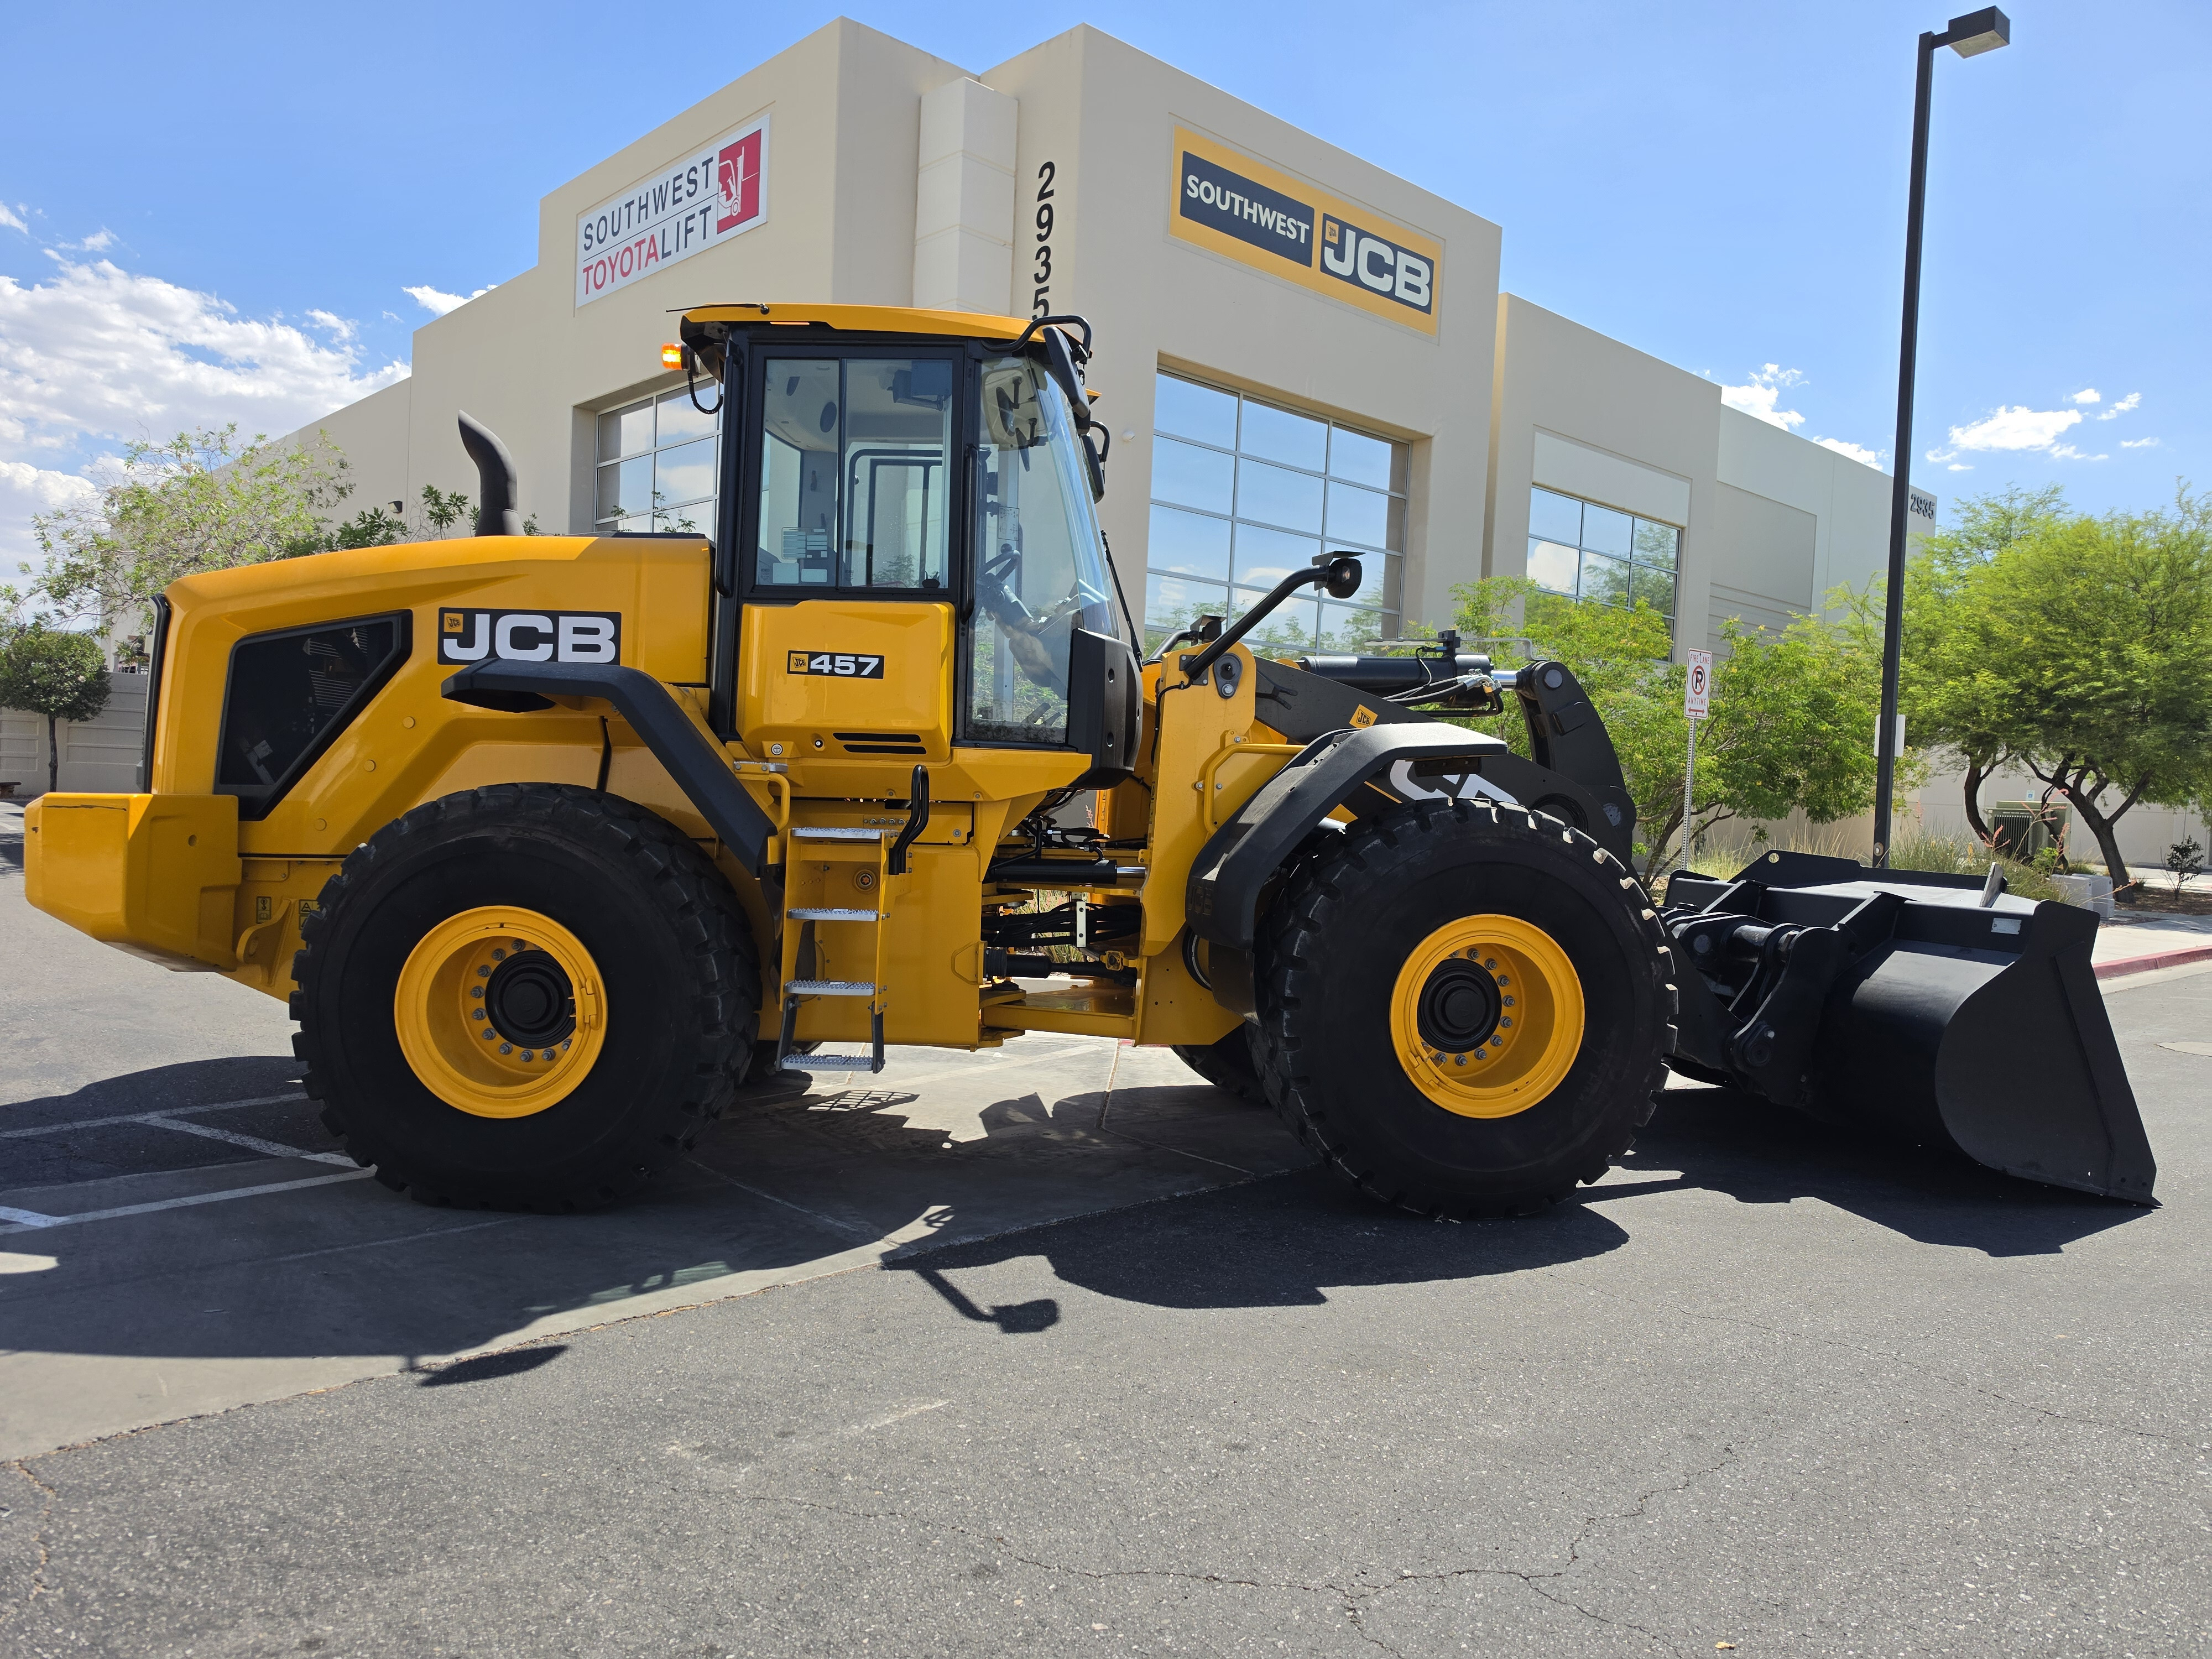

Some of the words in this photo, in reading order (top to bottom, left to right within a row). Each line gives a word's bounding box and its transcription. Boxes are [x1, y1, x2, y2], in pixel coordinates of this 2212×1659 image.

[583, 156, 713, 251] SOUTHWEST
[582, 205, 712, 295] TOYOTALIFT
[1187, 175, 1310, 243] SOUTHWEST
[1324, 228, 1430, 306] JCB
[1910, 494, 1935, 519] 2935
[444, 613, 615, 663] JCB
[795, 658, 805, 667] JCB
[810, 655, 879, 676] 457
[1691, 654, 1699, 662] FIRE
[1700, 655, 1710, 664] LANE
[1688, 697, 1706, 706] ANYTIME
[1358, 712, 1370, 725] JCB
